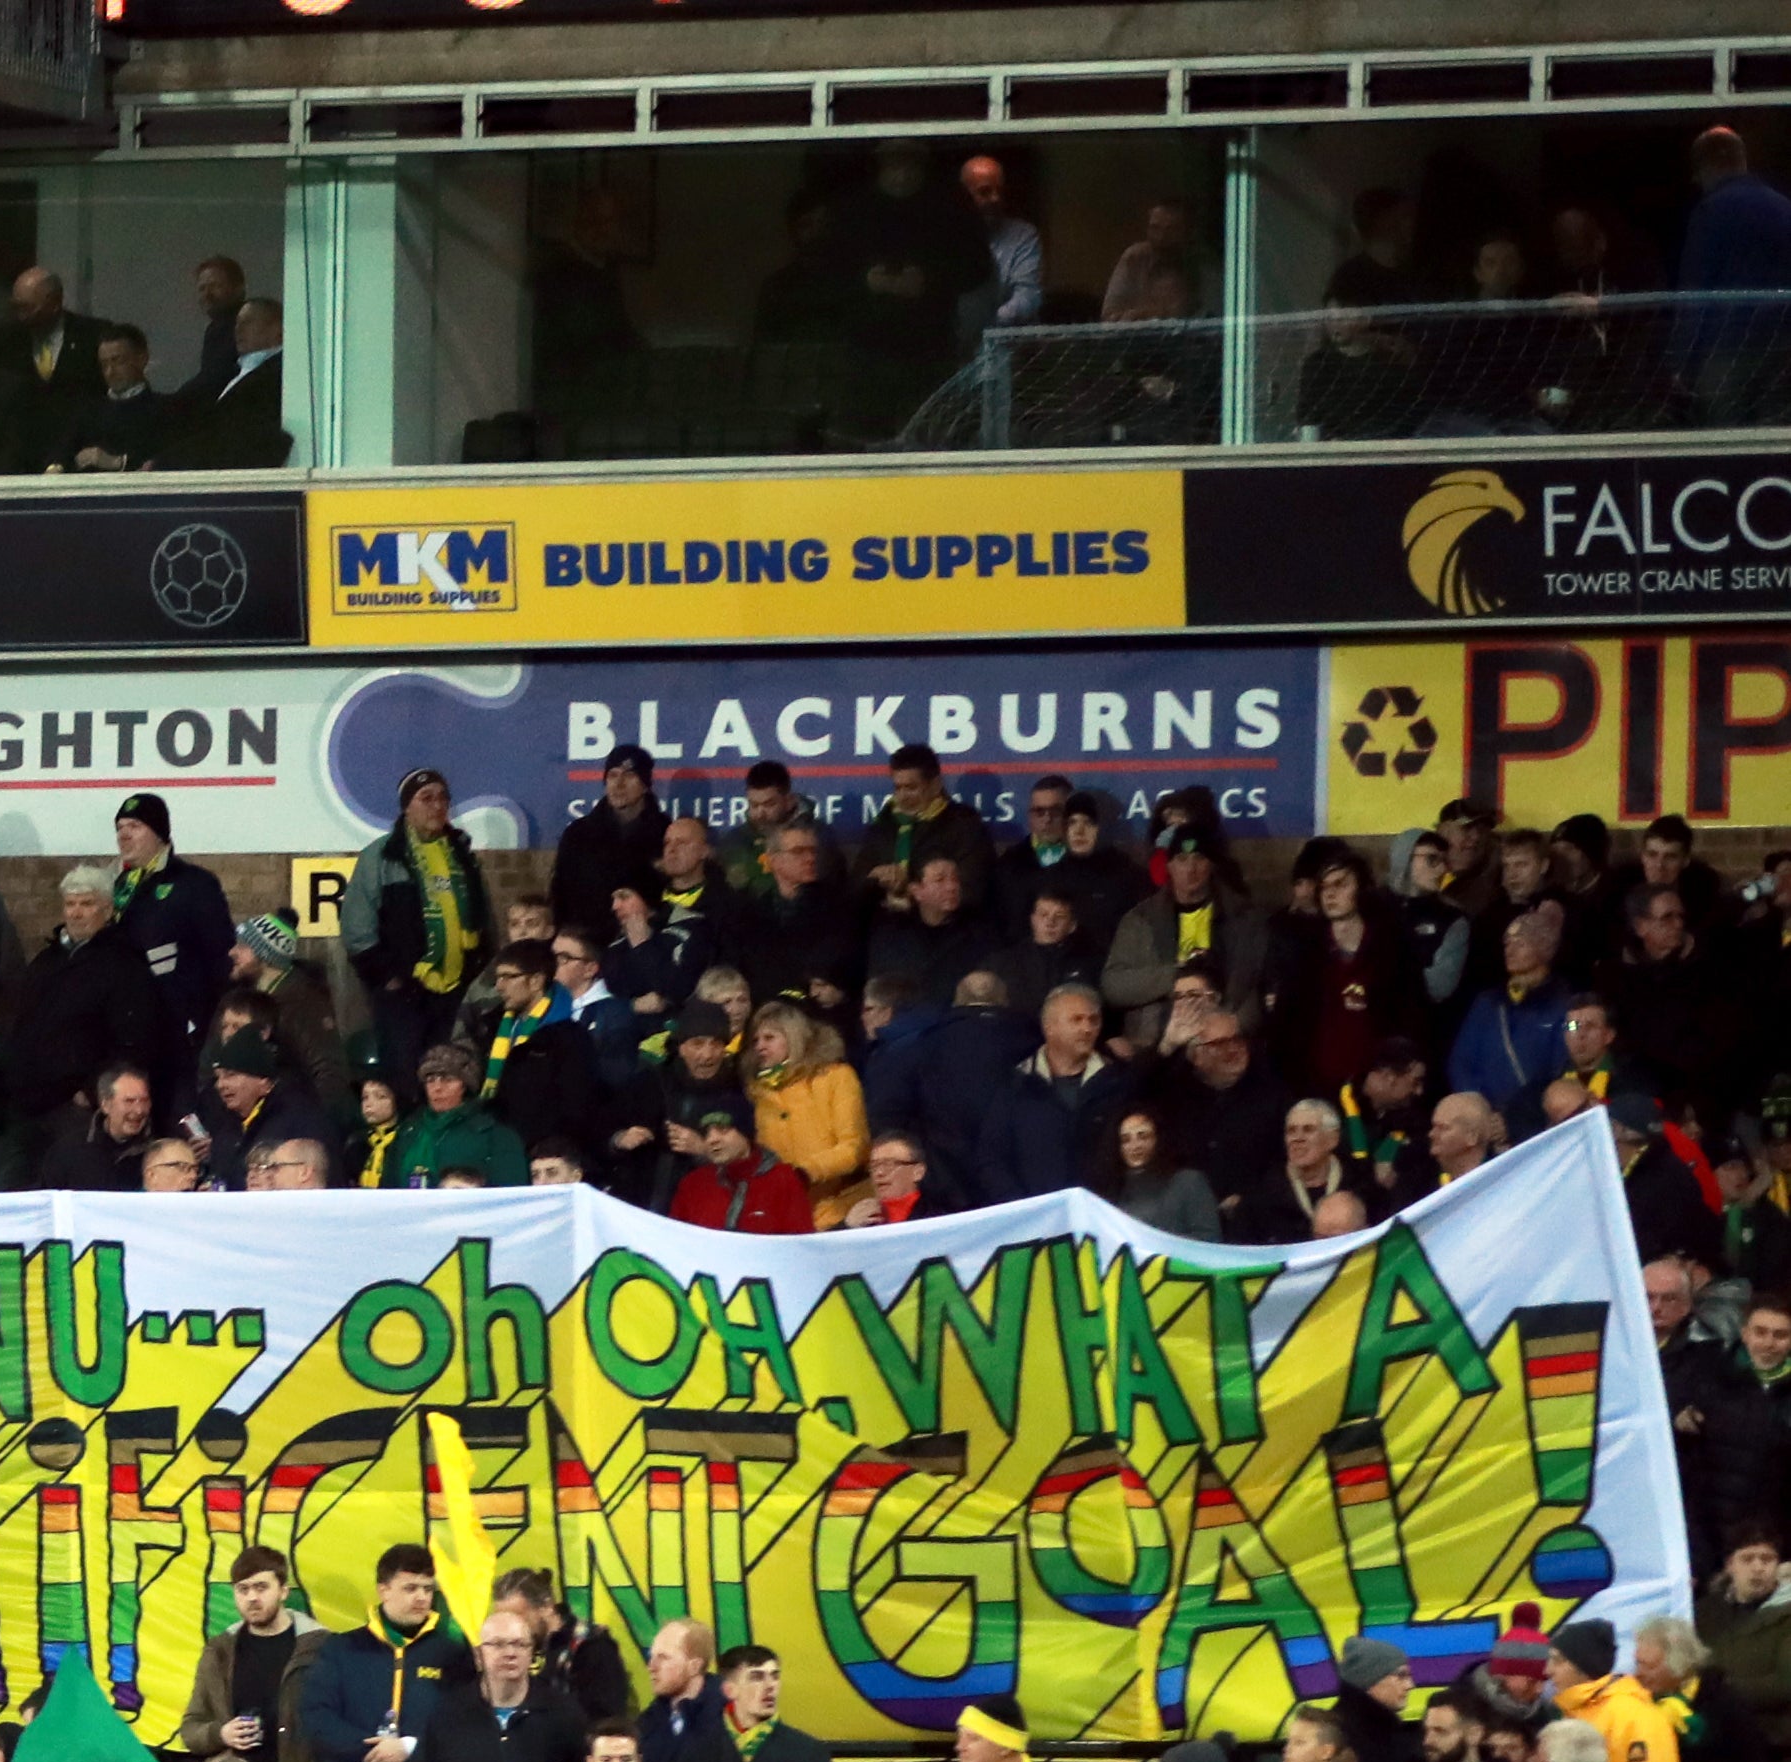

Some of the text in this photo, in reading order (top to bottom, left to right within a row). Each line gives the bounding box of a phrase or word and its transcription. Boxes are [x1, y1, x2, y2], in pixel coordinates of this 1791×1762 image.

[338, 529, 508, 609] MKM
[544, 529, 1150, 588] BUILDING SUPPLIES
[1544, 571, 1630, 596] TOWER
[1638, 568, 1722, 593] CRANE
[346, 589, 501, 607] BUILDING SUPPLIES
[568, 688, 1281, 762] BLACKBURNS
[833, 1234, 1288, 1445] WHAT
[1340, 1217, 1499, 1424] A
